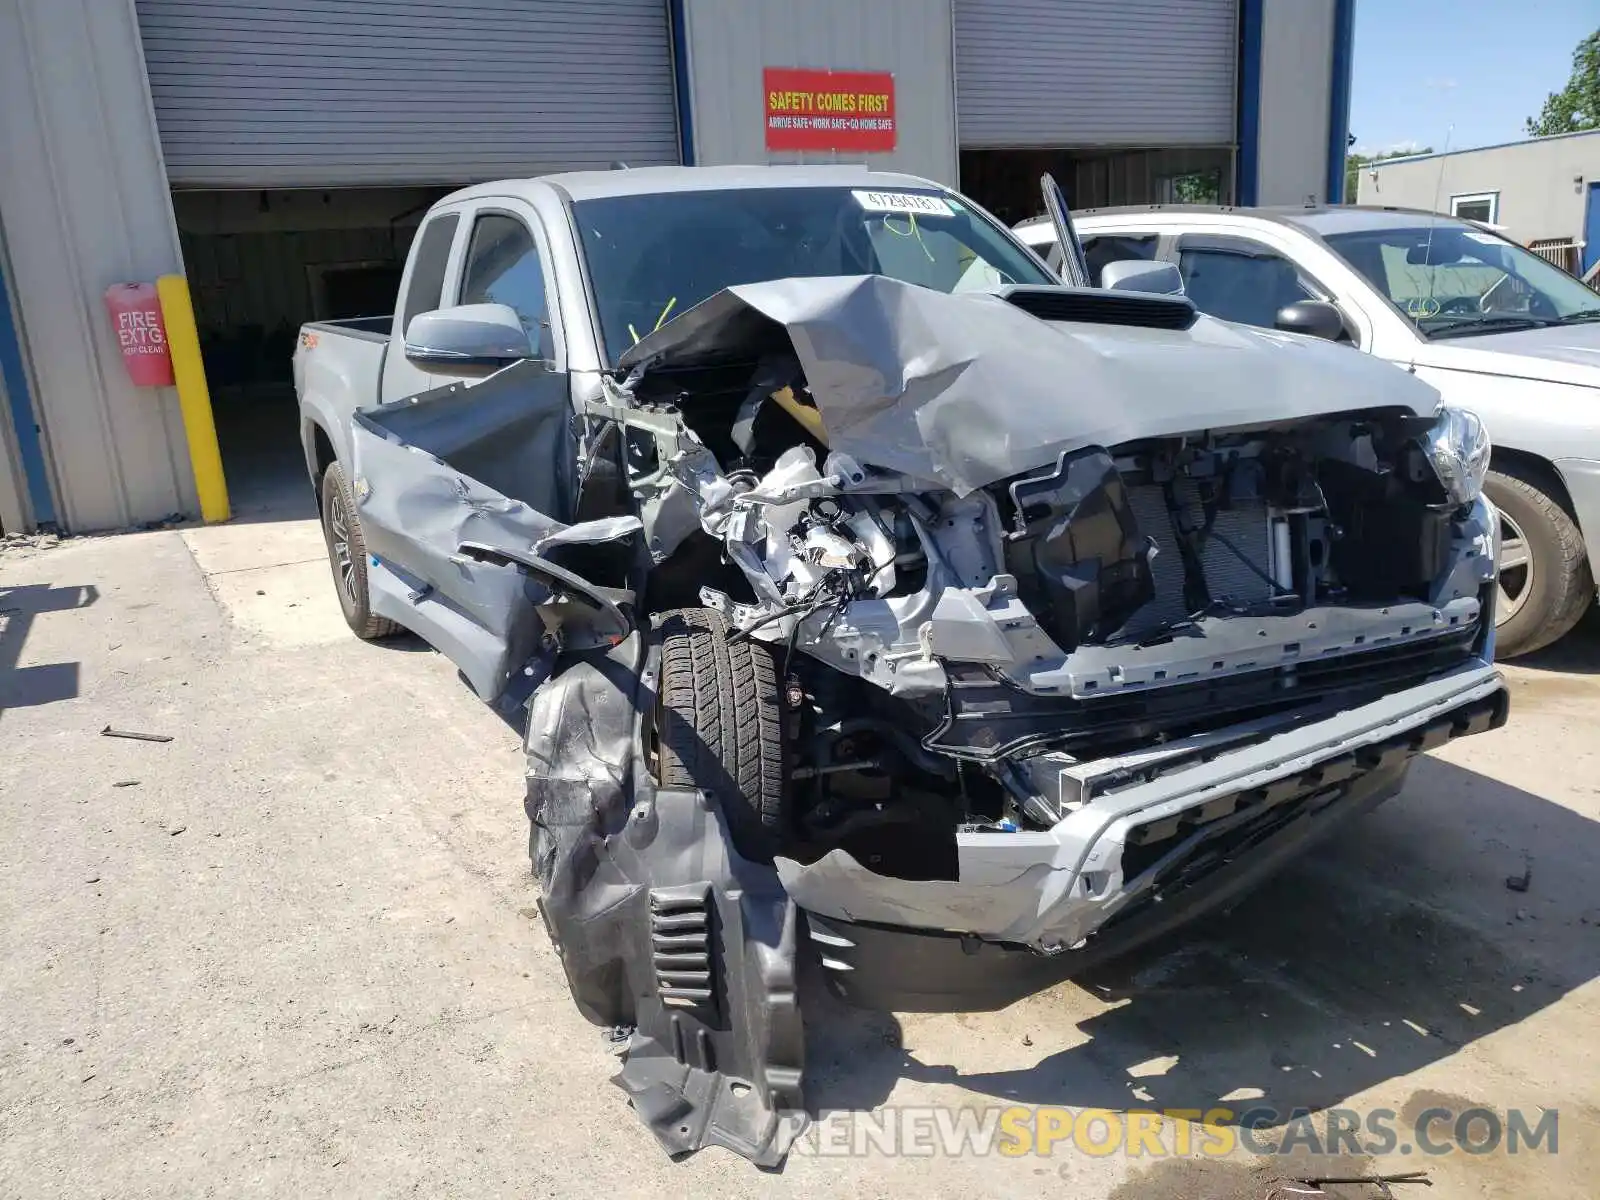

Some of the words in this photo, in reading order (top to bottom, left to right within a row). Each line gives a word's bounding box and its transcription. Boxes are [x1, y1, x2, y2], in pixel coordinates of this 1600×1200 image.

[769, 91, 814, 111] SAFETY
[817, 93, 856, 112] COMES
[858, 94, 889, 112] FIRST
[118, 311, 158, 329] FIRE
[118, 328, 167, 346] EXTG.
